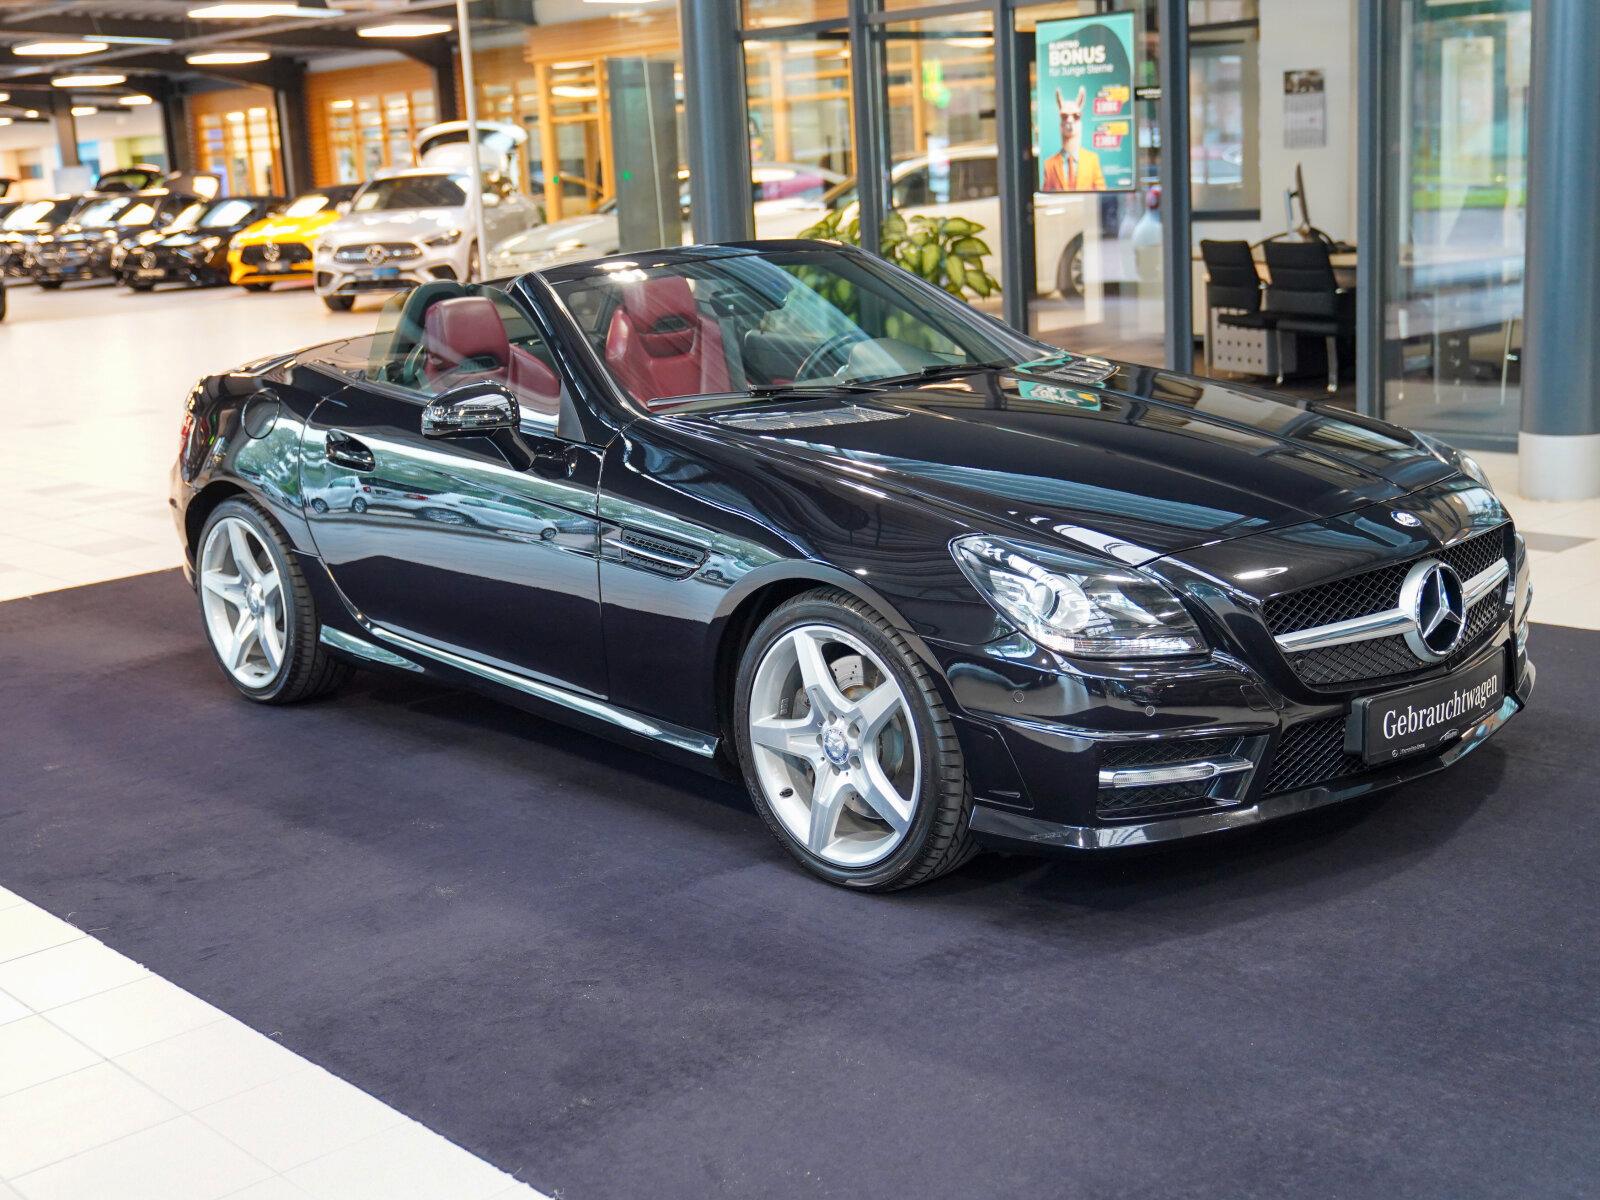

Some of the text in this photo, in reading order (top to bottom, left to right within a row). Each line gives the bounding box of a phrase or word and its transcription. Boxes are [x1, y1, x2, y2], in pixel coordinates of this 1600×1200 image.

[1049, 45, 1106, 67] BONUS
[1061, 66, 1086, 77] Junge
[1087, 64, 1114, 74] Sterne
[1383, 674, 1498, 740] Gebrauchtwagen
